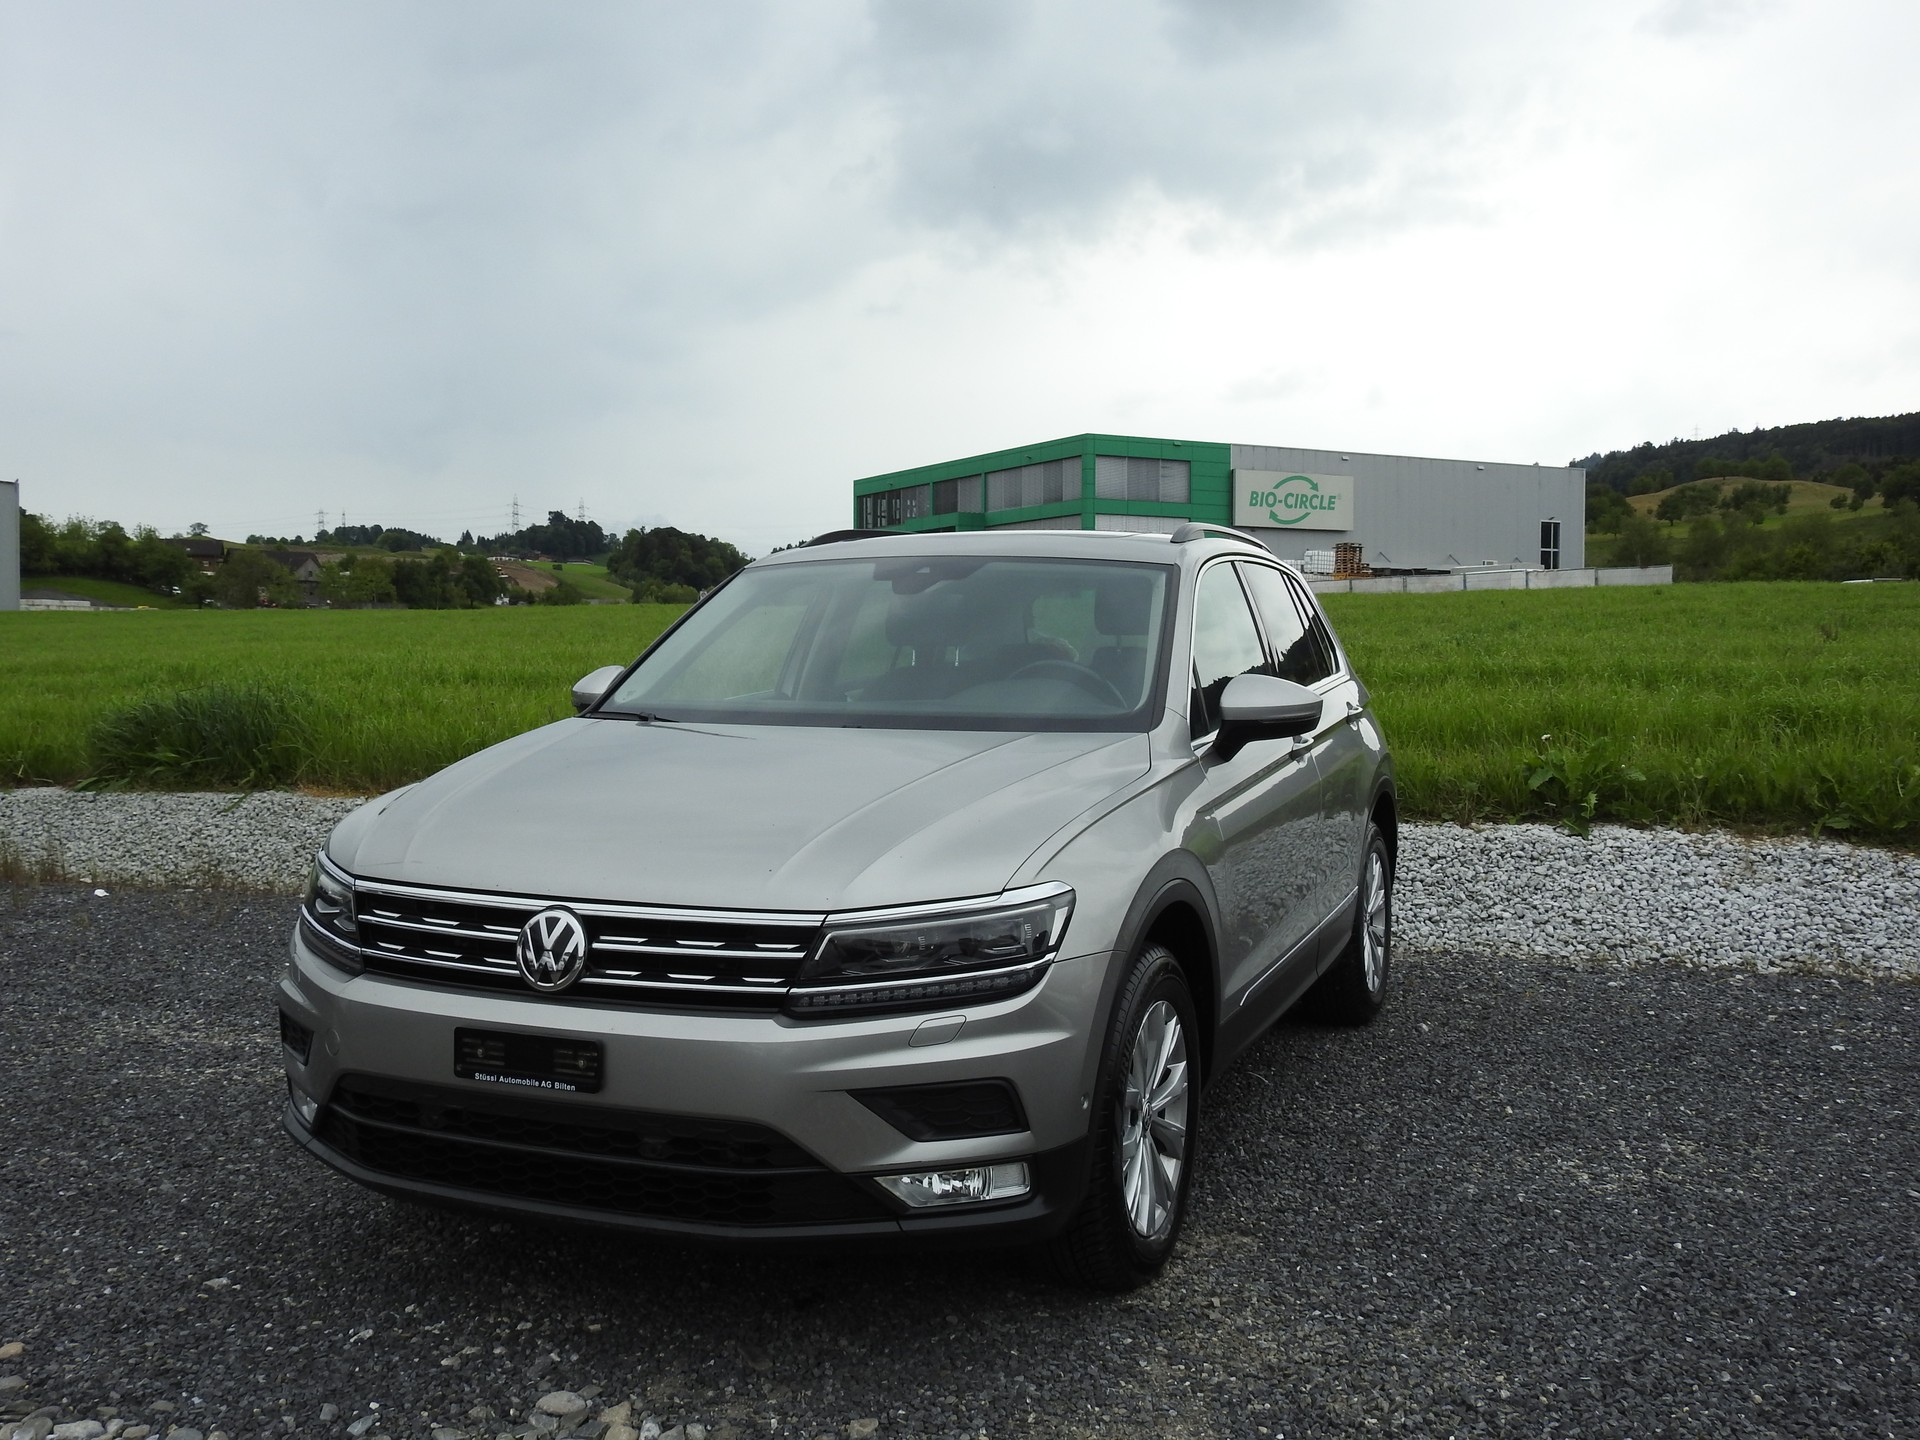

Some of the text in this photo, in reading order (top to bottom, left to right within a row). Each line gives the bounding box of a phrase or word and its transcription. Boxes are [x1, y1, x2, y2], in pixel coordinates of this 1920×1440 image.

[1249, 491, 1337, 511] BIO-CIRCLE
[499, 1076, 540, 1087] Automobile
[541, 1080, 552, 1089] AG
[554, 1082, 576, 1091] Bilten
